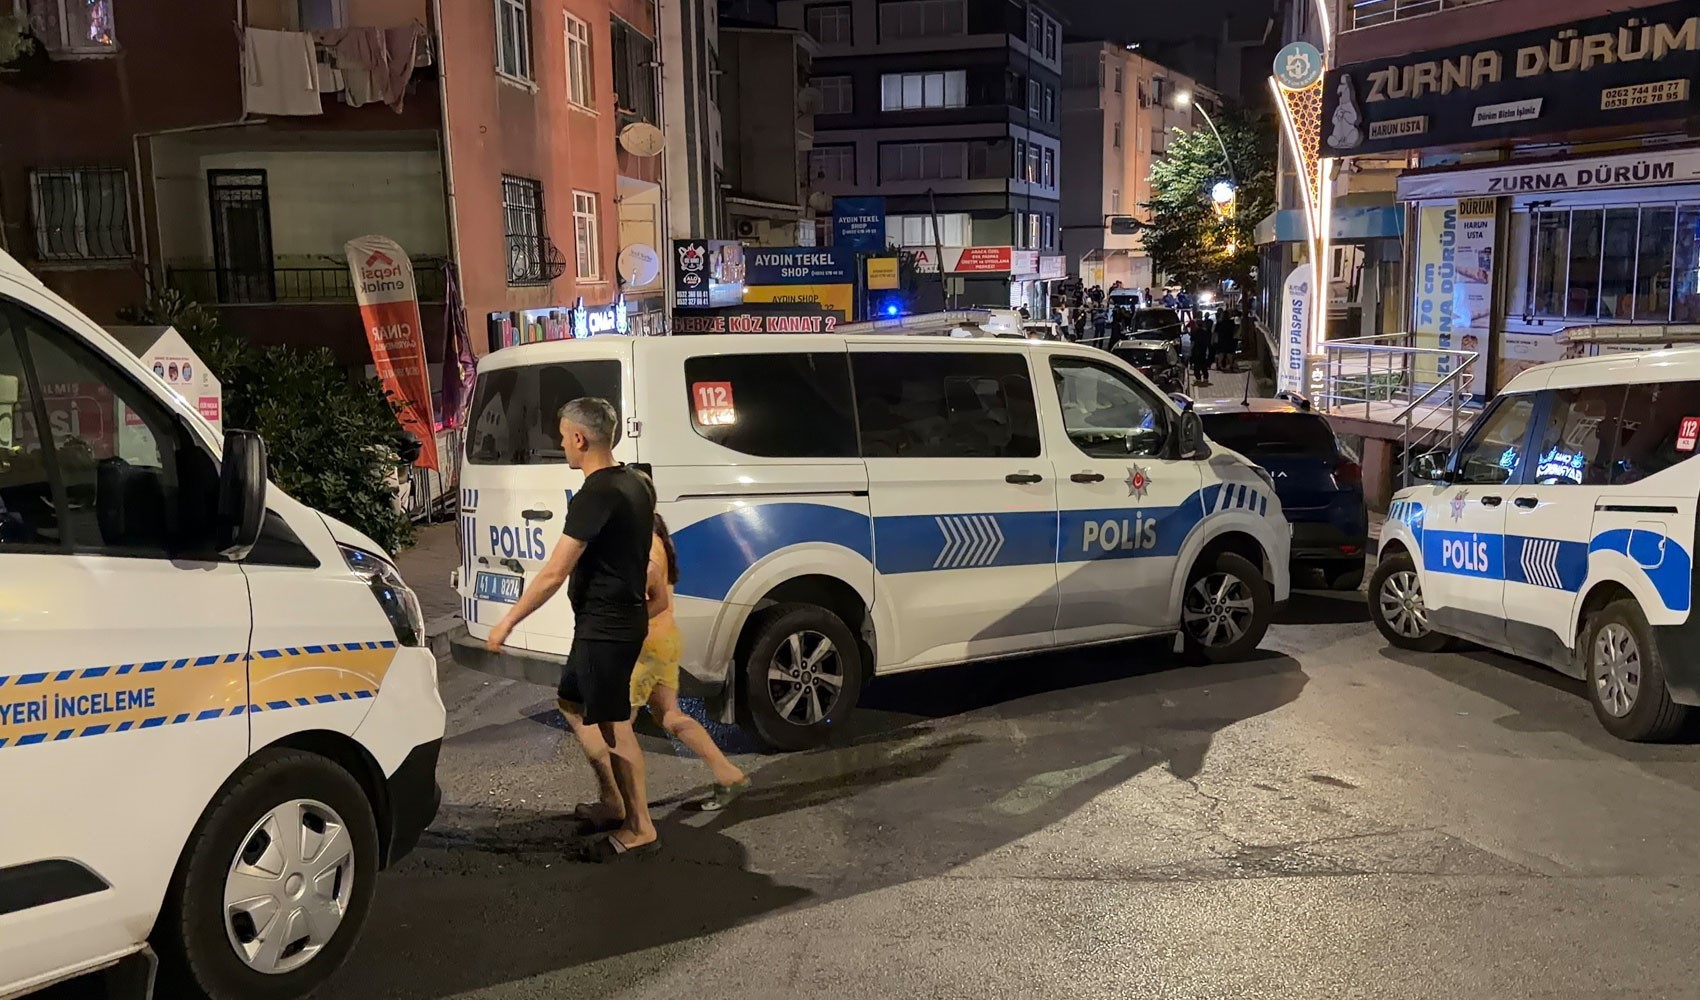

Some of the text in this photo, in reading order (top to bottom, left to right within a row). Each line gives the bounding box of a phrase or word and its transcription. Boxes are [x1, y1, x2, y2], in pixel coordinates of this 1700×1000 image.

[1366, 17, 1700, 103] ZURNA DÜRÜM
[1604, 98, 1628, 108] 0538
[1631, 96, 1648, 104] 702
[1666, 92, 1678, 100] 95
[1606, 89, 1629, 98] 0262
[1632, 87, 1649, 95] 744
[1667, 82, 1679, 91] 77
[1371, 121, 1421, 137] HARUN USTA
[1487, 161, 1675, 192] ZURNA DÜRÜM
[1460, 198, 1494, 215] DÜRÜM
[1463, 221, 1488, 229] HARUN
[1467, 231, 1483, 239] USTA
[755, 253, 834, 266] AYDIN TEKEL
[1438, 209, 1456, 294] DÜRÜM
[781, 267, 809, 277] SHOP
[772, 294, 819, 303] AYDIN SHOP
[1420, 263, 1434, 325] 70 cm
[672, 314, 837, 333] GEBZE KÖZ KANAT 2
[1291, 299, 1303, 345] PASPAS
[1290, 347, 1301, 370] OTO
[699, 386, 729, 407] 112
[1682, 420, 1697, 437] 112
[489, 519, 546, 560] POLİS
[1082, 511, 1156, 552] POLİS
[1442, 533, 1488, 572] POLİS
[480, 575, 520, 597] 41 A 8274
[0, 687, 155, 725] YERİ İNCELEME
